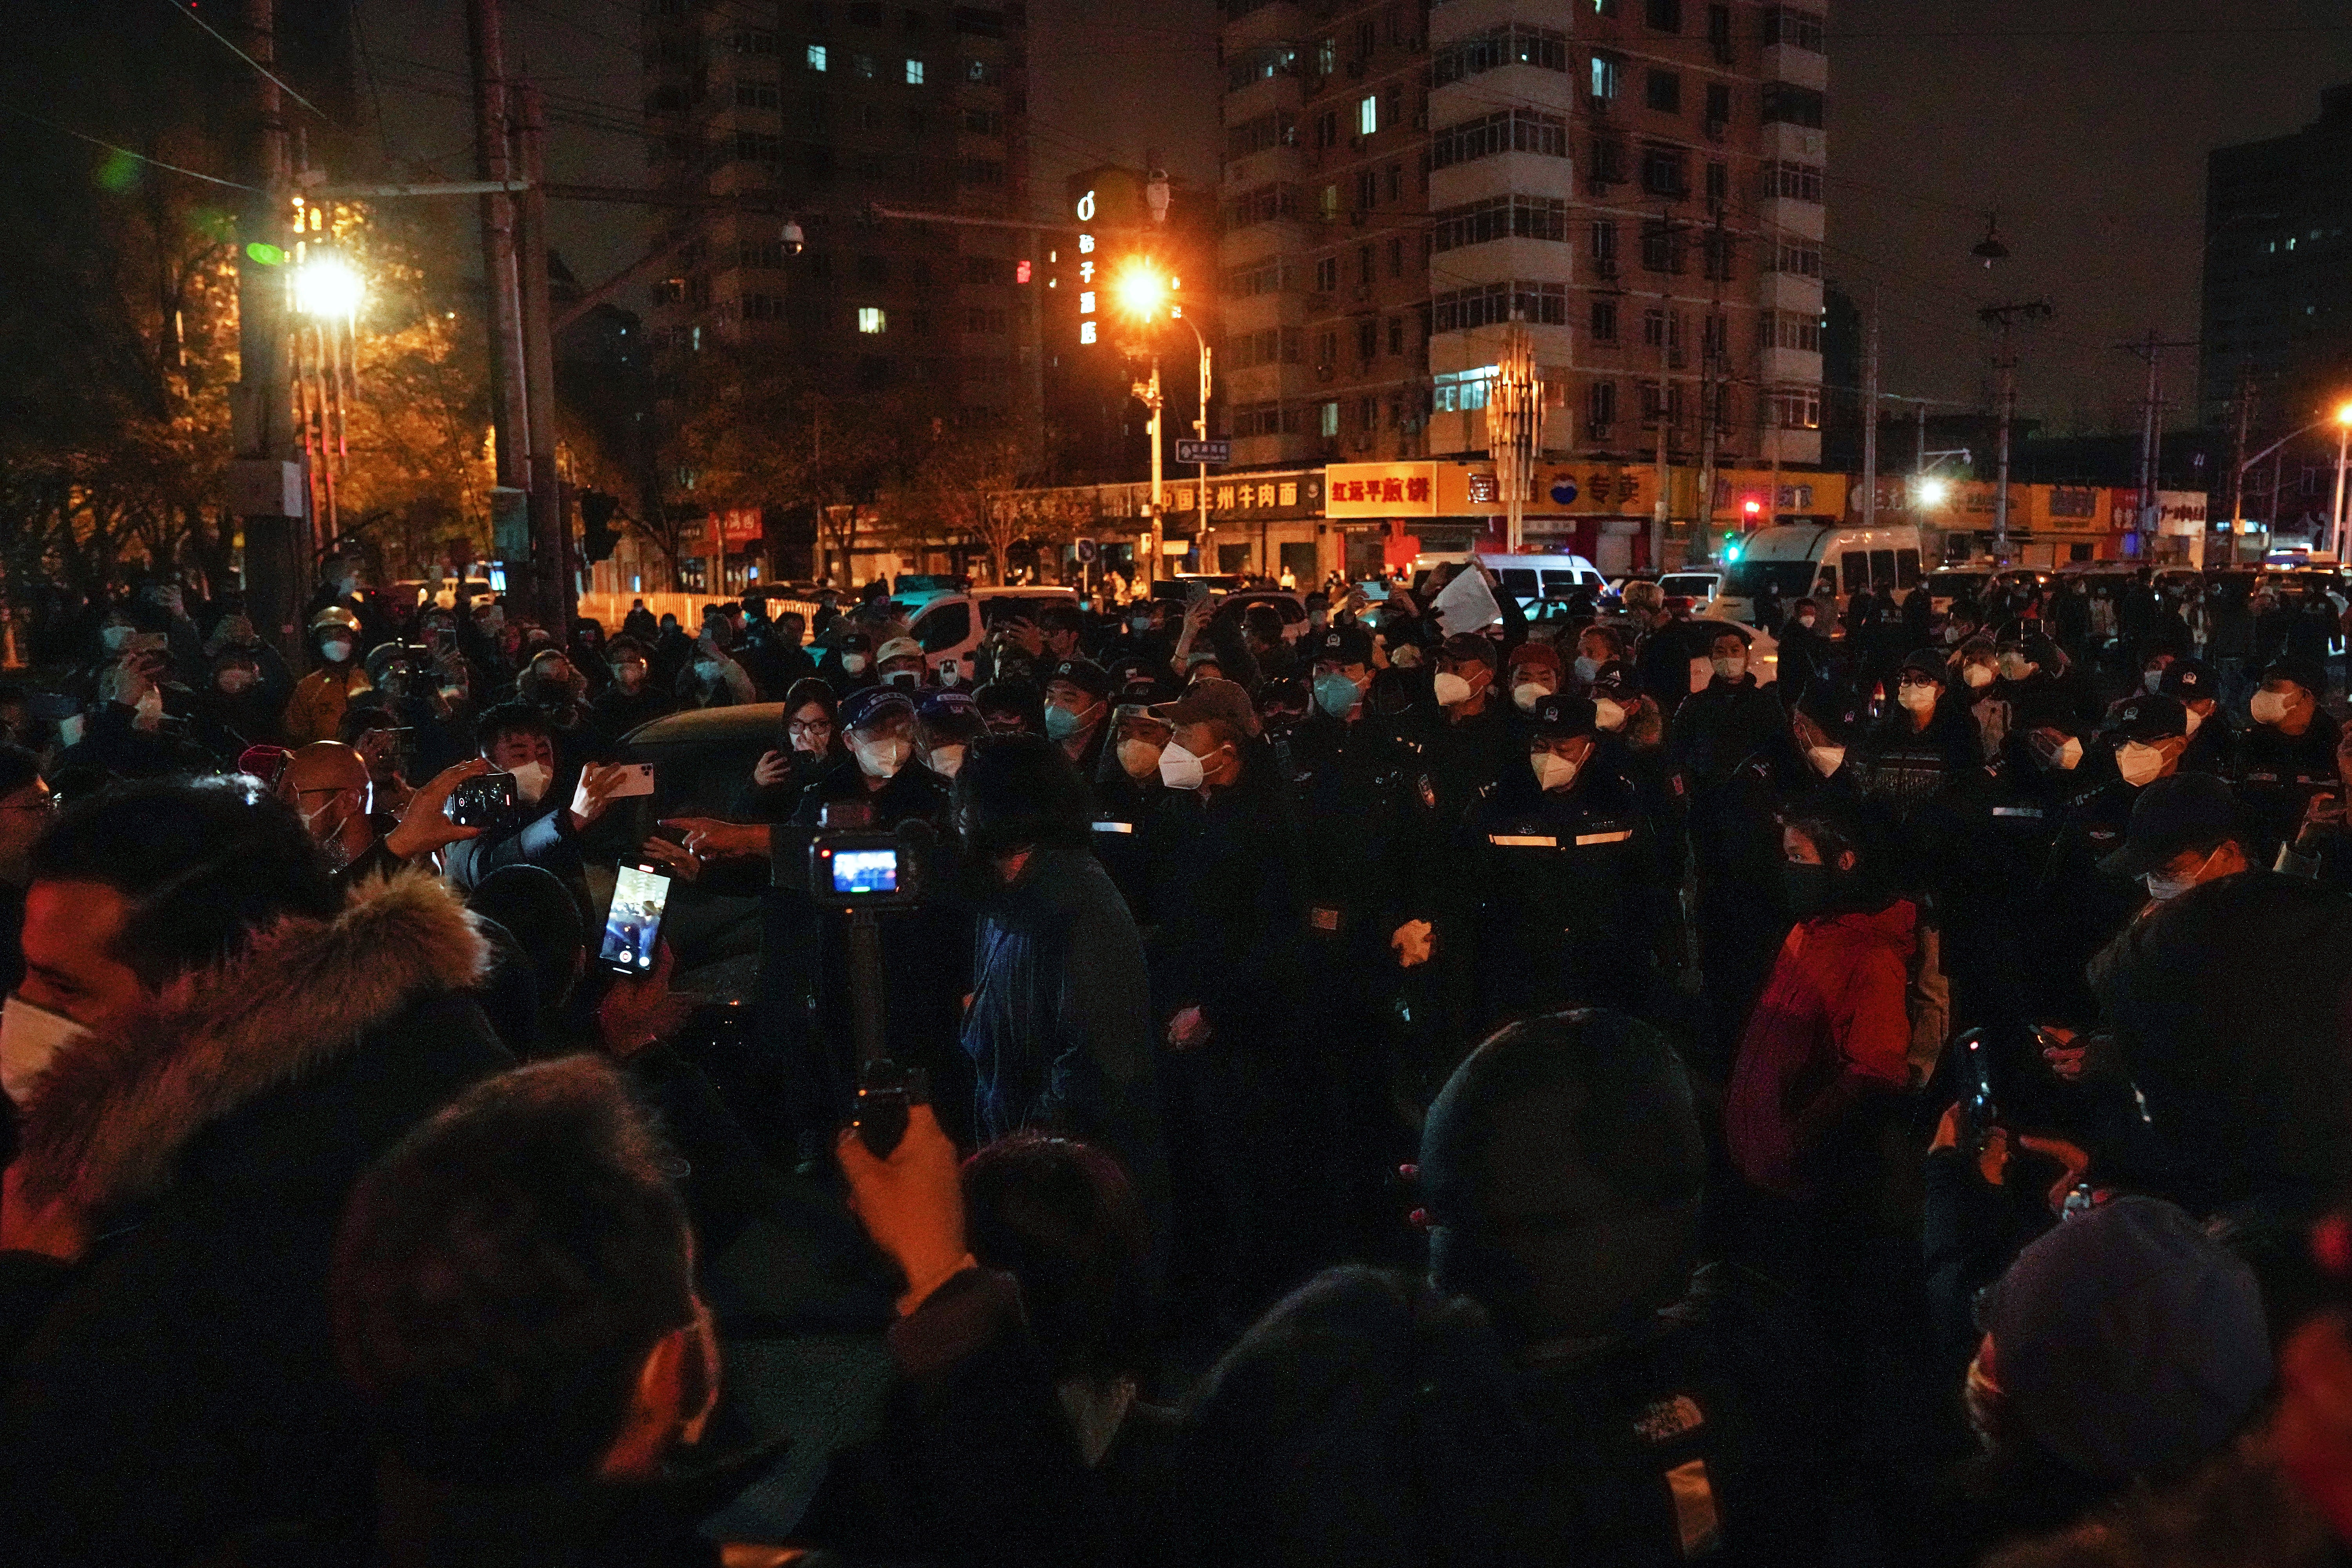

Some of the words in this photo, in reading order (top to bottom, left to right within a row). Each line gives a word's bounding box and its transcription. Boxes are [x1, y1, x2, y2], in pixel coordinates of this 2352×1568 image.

[1161, 482, 1297, 513] 中国兰州牛肉面
